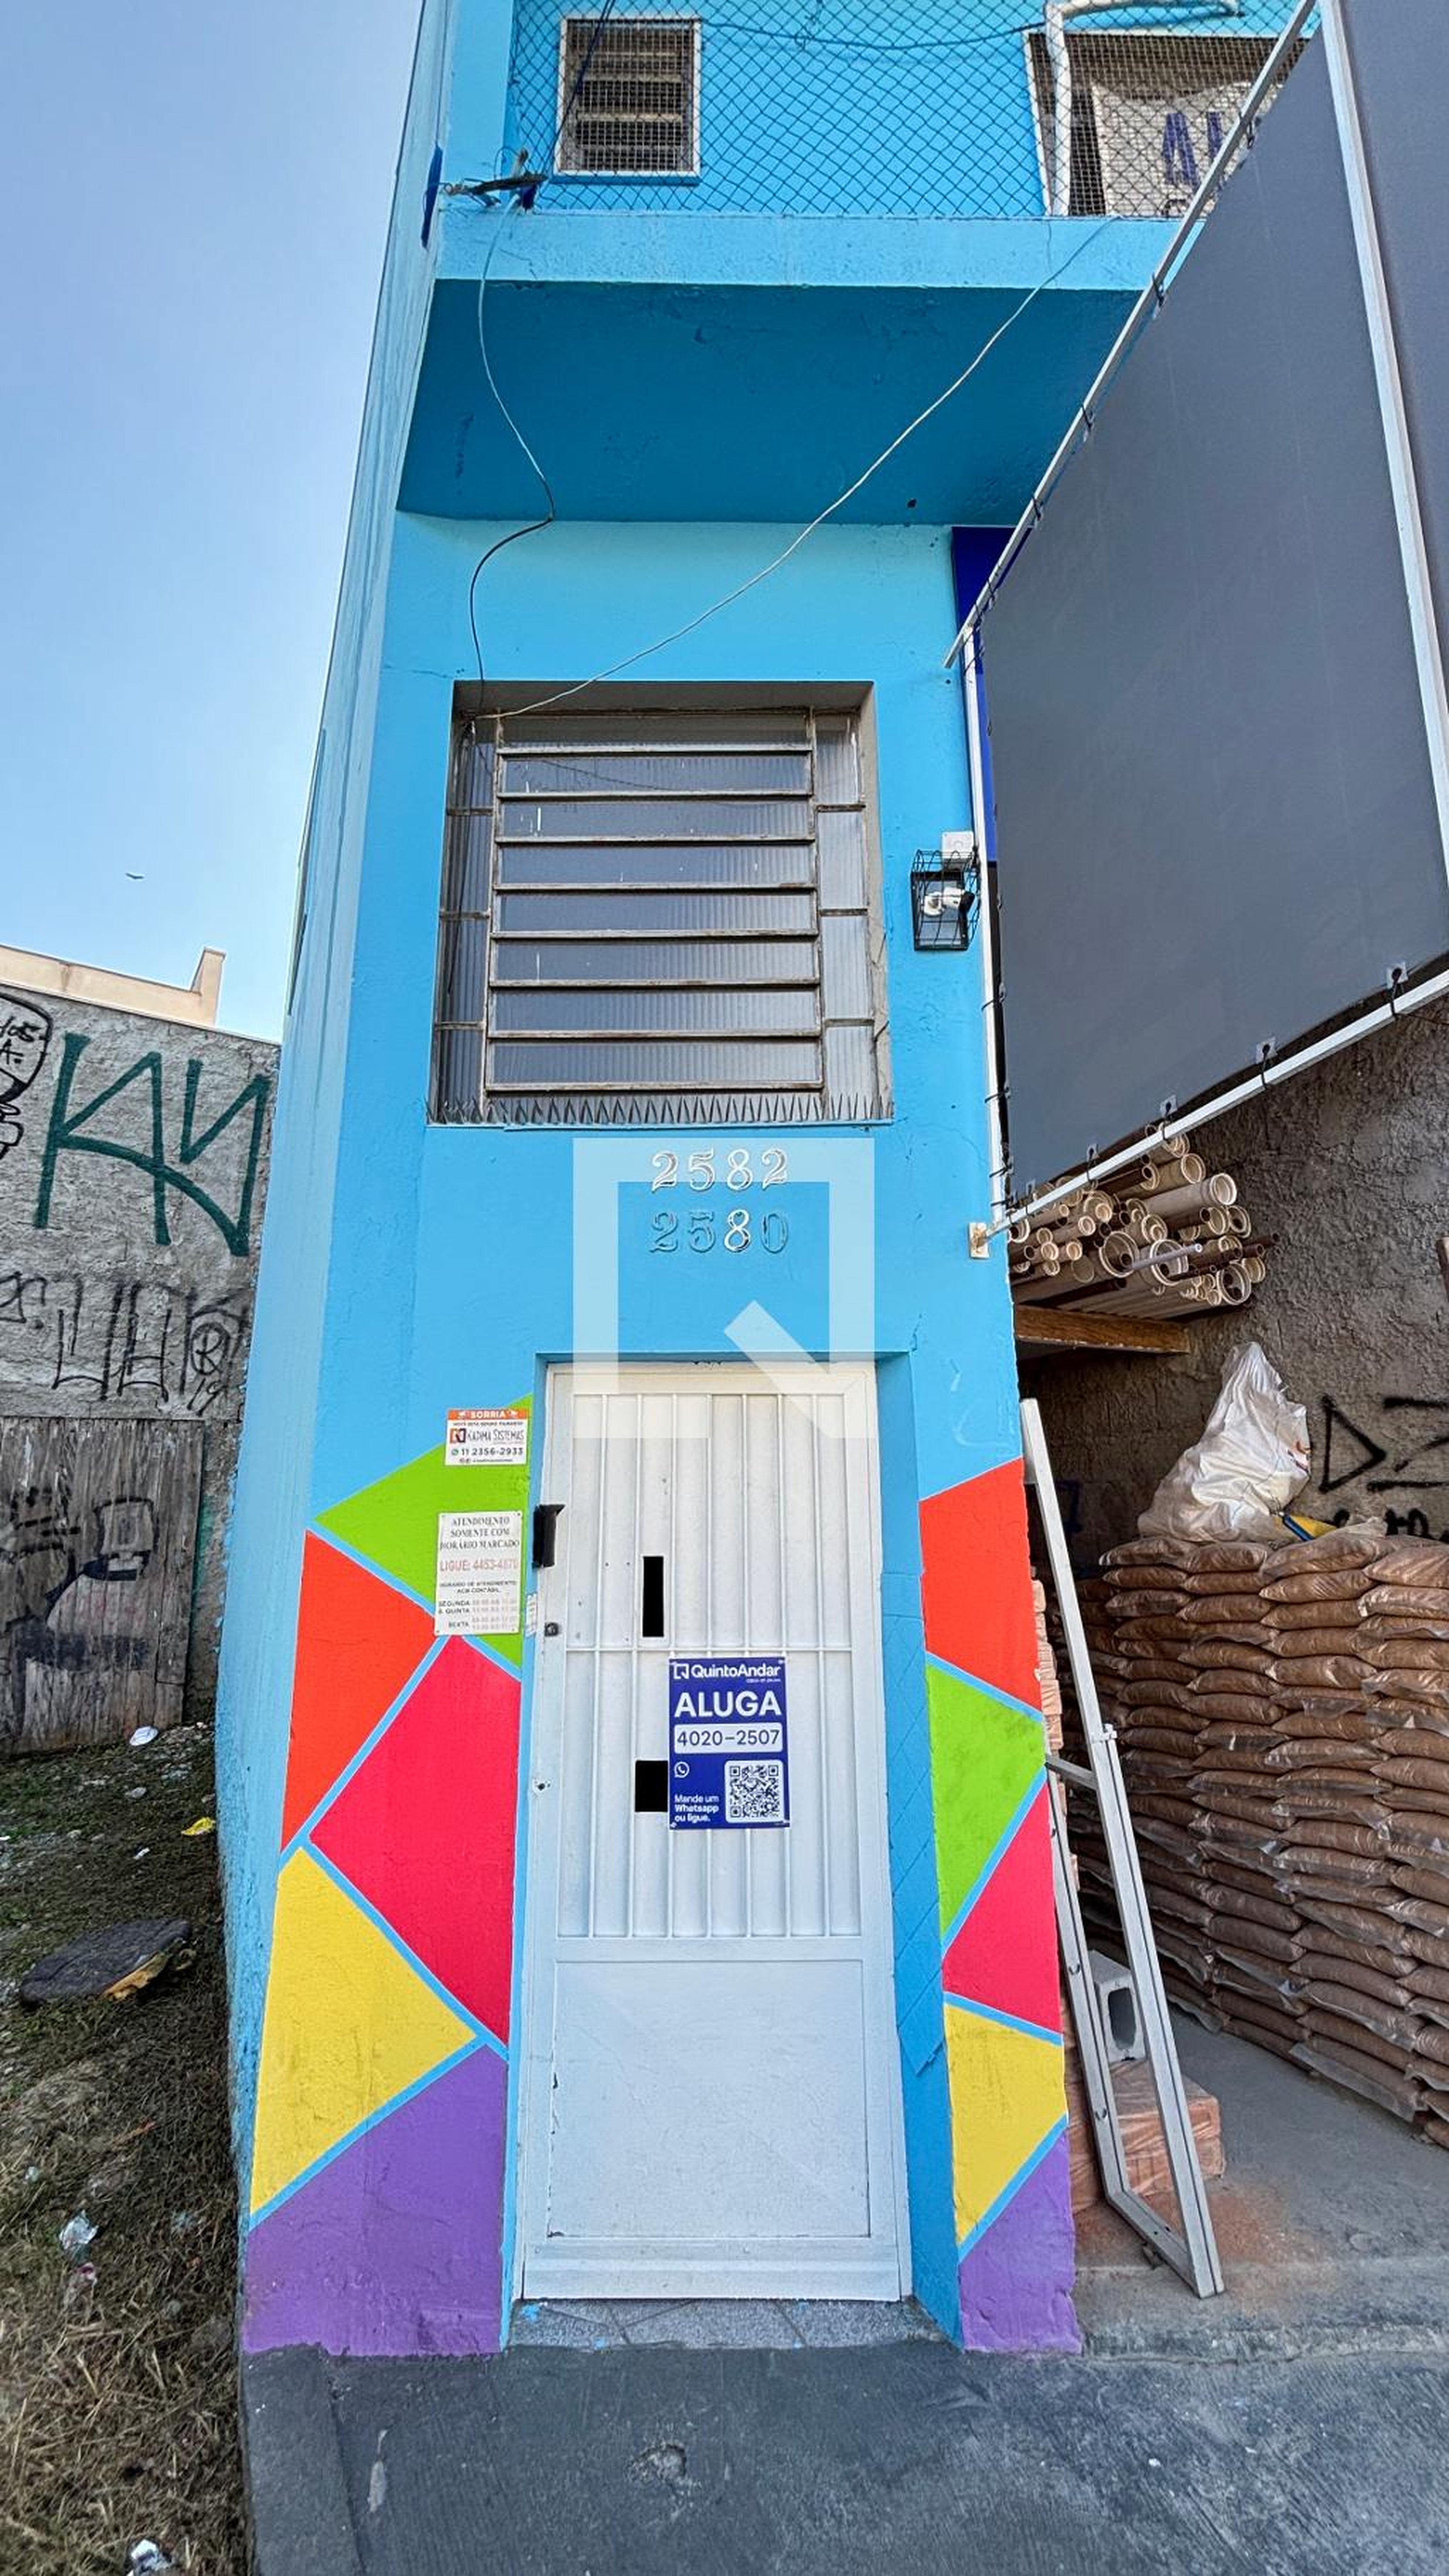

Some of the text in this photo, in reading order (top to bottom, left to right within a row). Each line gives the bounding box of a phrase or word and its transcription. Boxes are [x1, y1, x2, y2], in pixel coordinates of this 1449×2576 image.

[651, 1148, 788, 1194] 2582
[649, 1209, 789, 1253] 2580
[471, 1410, 507, 1419] SORRIA
[451, 1529, 489, 1537] SOMENTE
[479, 1540, 520, 1549] MARCADO
[691, 1663, 781, 1678] QuintoAndar
[674, 1690, 782, 1717] ALUGA
[677, 1729, 780, 1746] 4020-2507
[674, 1794, 703, 1803] Mande
[674, 1804, 720, 1814] Whatsapp
[687, 1813, 711, 1824] ligue.
